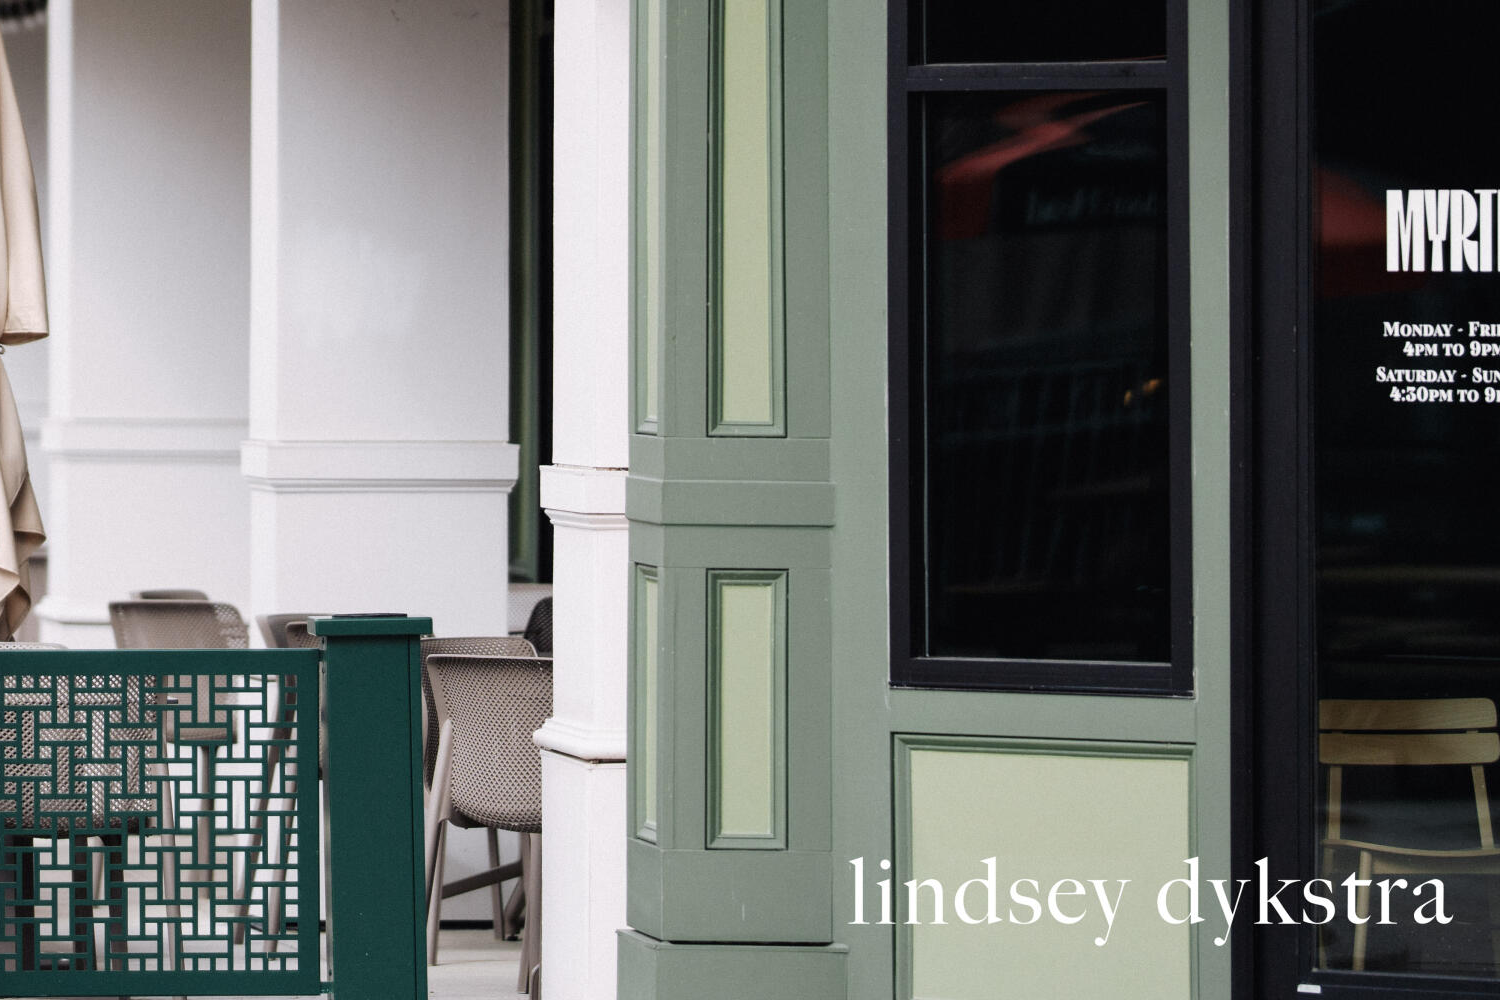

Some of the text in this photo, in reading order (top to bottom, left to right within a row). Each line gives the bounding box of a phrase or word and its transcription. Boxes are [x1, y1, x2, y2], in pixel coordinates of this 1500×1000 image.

[1386, 188, 1500, 273] MYRT
[1383, 321, 1454, 337] MONDAY
[1402, 340, 1439, 357] 4PM
[1441, 343, 1465, 357] TO
[1375, 366, 1457, 383] SATURDAY
[1389, 385, 1454, 403] 4:30PM
[1456, 389, 1480, 403] TO
